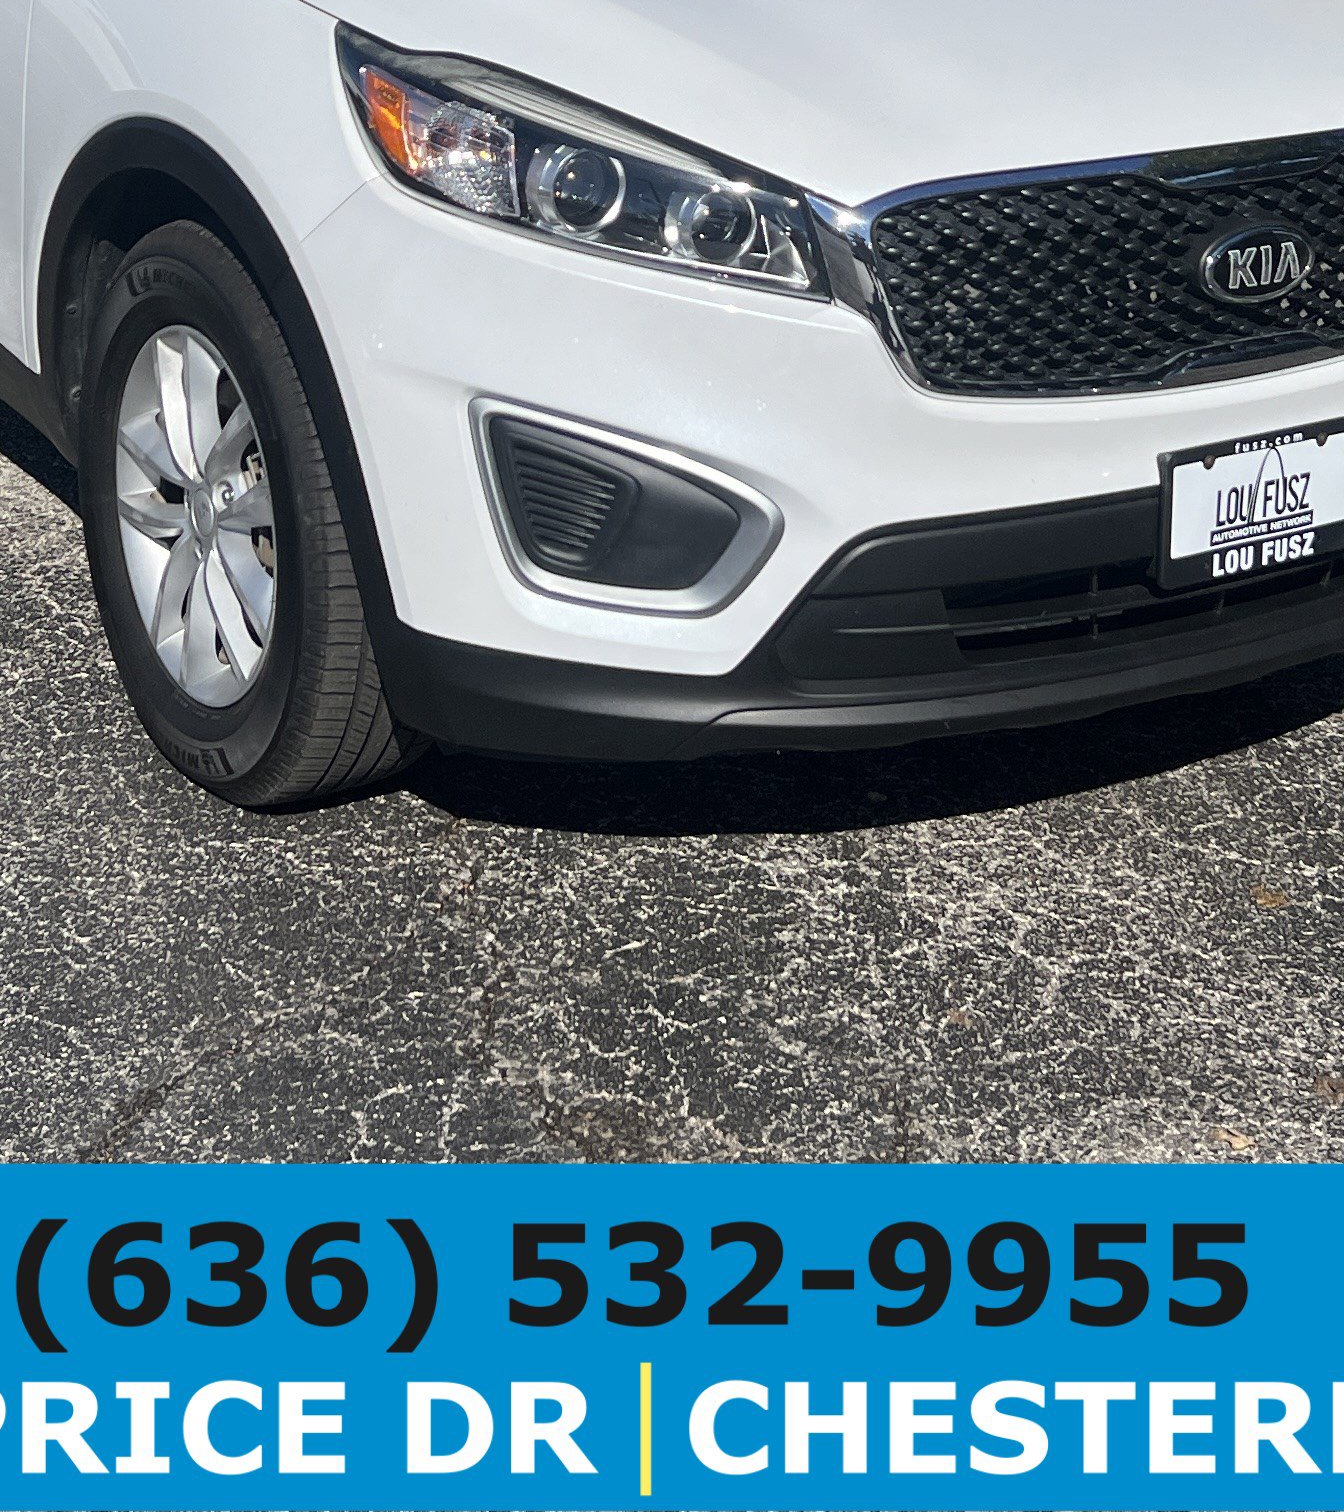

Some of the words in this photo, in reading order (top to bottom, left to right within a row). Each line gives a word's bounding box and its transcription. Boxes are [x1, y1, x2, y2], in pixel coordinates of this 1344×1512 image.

[1227, 241, 1300, 290] KIA
[1234, 432, 1303, 453] fusz.com
[1216, 483, 1254, 527] LOU
[1262, 472, 1311, 518] FUSZ
[1212, 523, 1268, 543] AUTOMOTIVE
[1269, 514, 1312, 530] NETWORK
[1212, 545, 1255, 578] LOU
[1261, 531, 1315, 566] FUSZ
